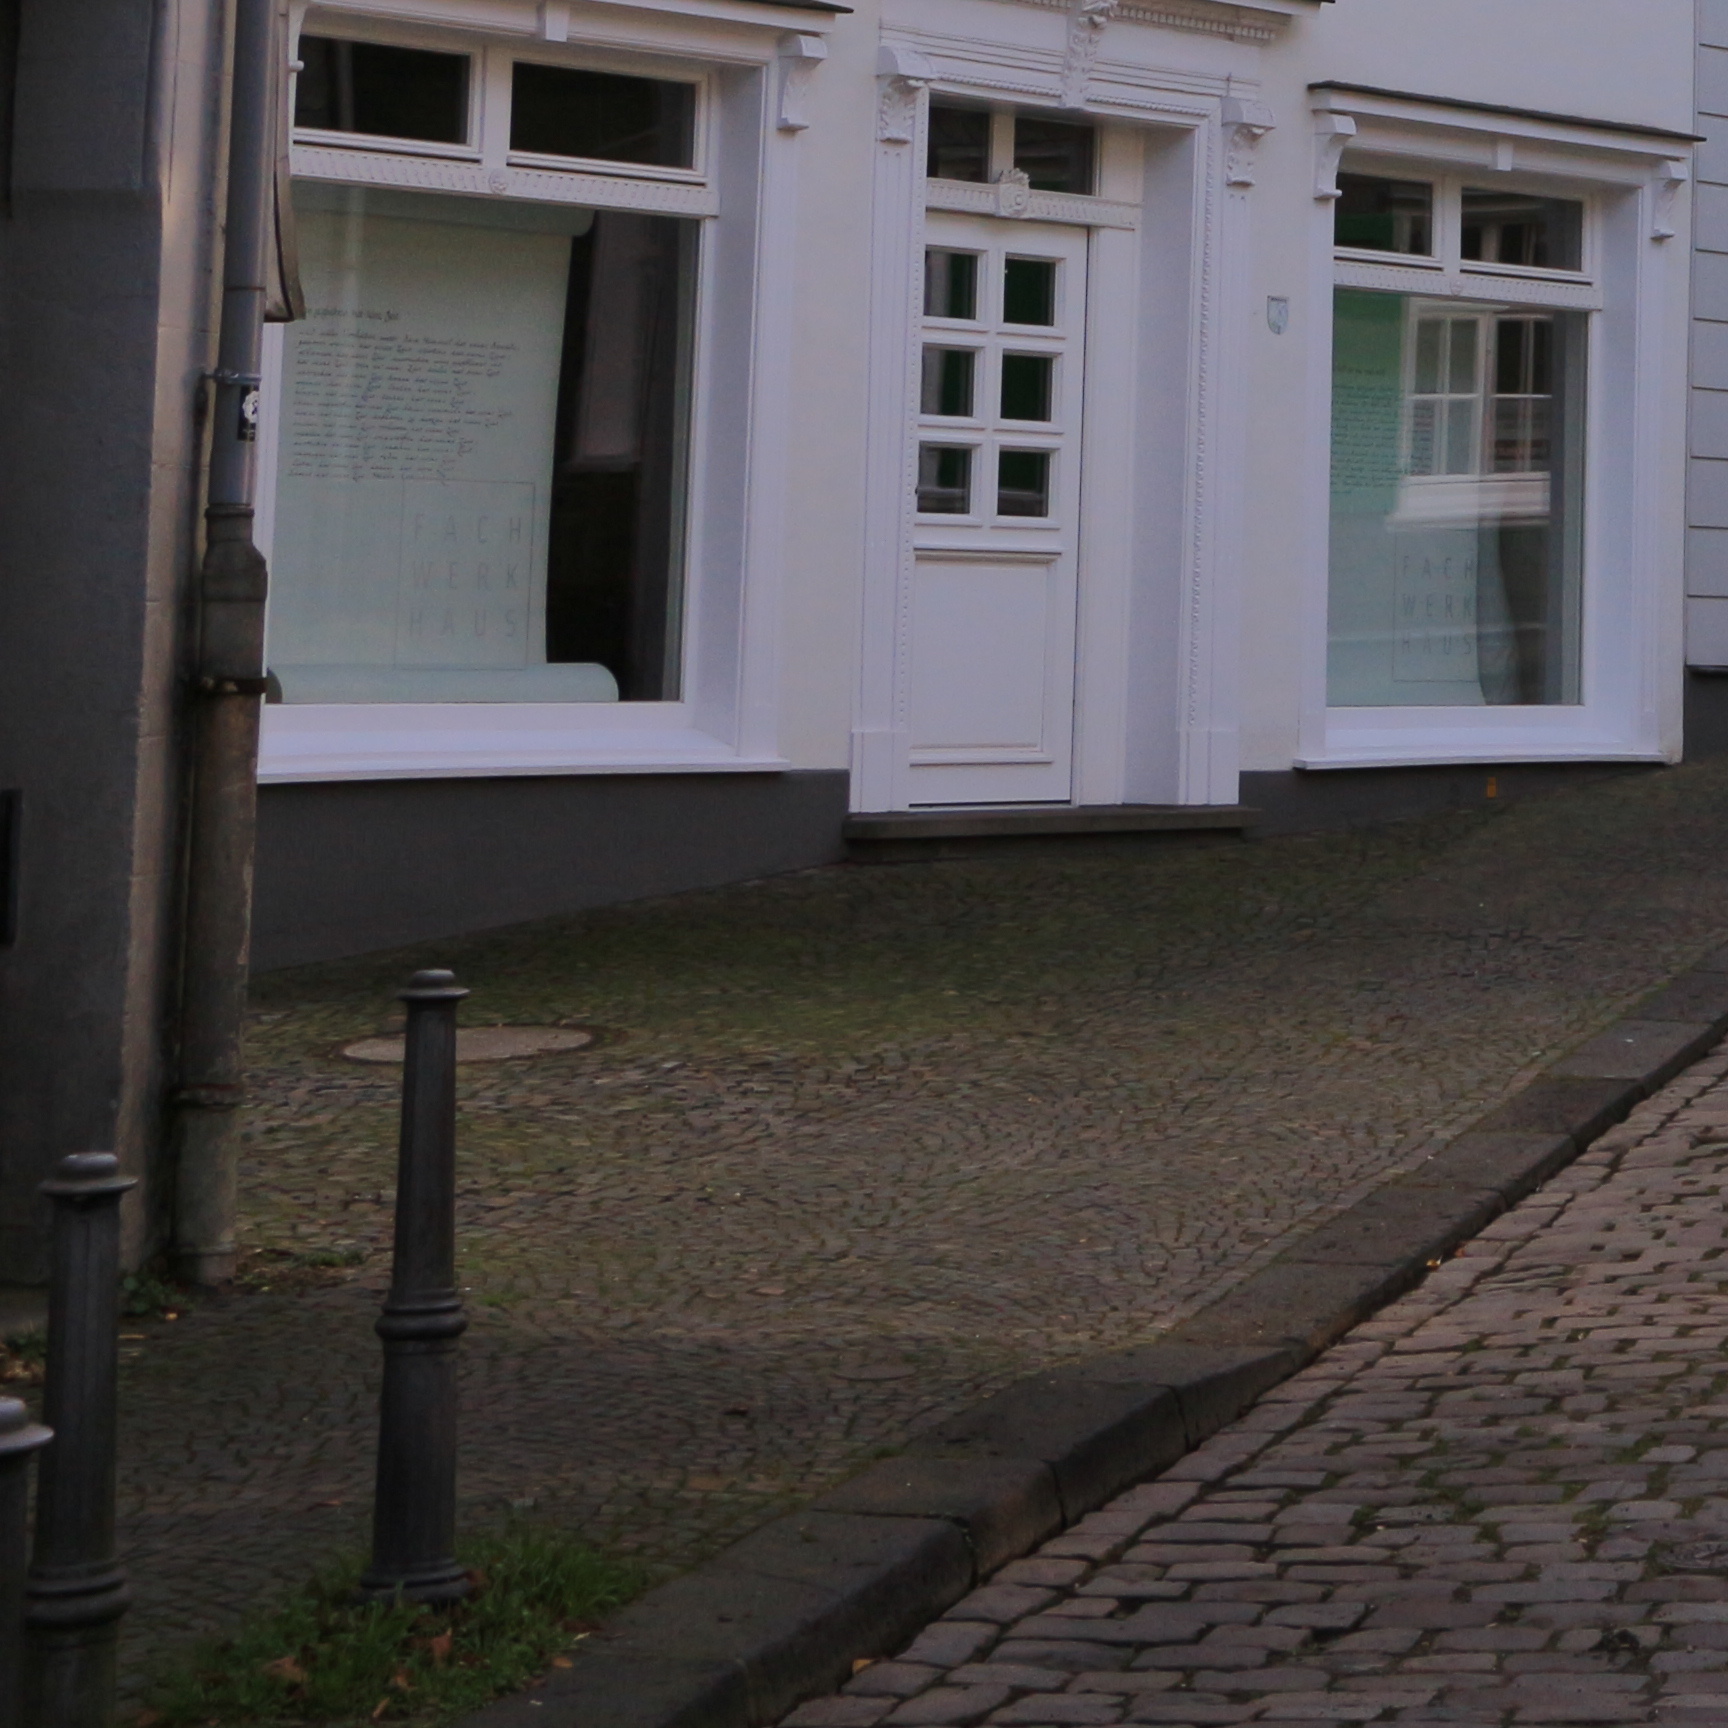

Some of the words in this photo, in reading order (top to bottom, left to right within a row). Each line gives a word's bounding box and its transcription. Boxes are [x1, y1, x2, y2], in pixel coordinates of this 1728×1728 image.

[413, 512, 522, 544] FACH
[411, 559, 520, 592] WERK
[1402, 554, 1474, 580] FACH
[1401, 592, 1474, 619] WERK
[408, 606, 518, 638] HAUS
[1400, 632, 1472, 656] HAUS
